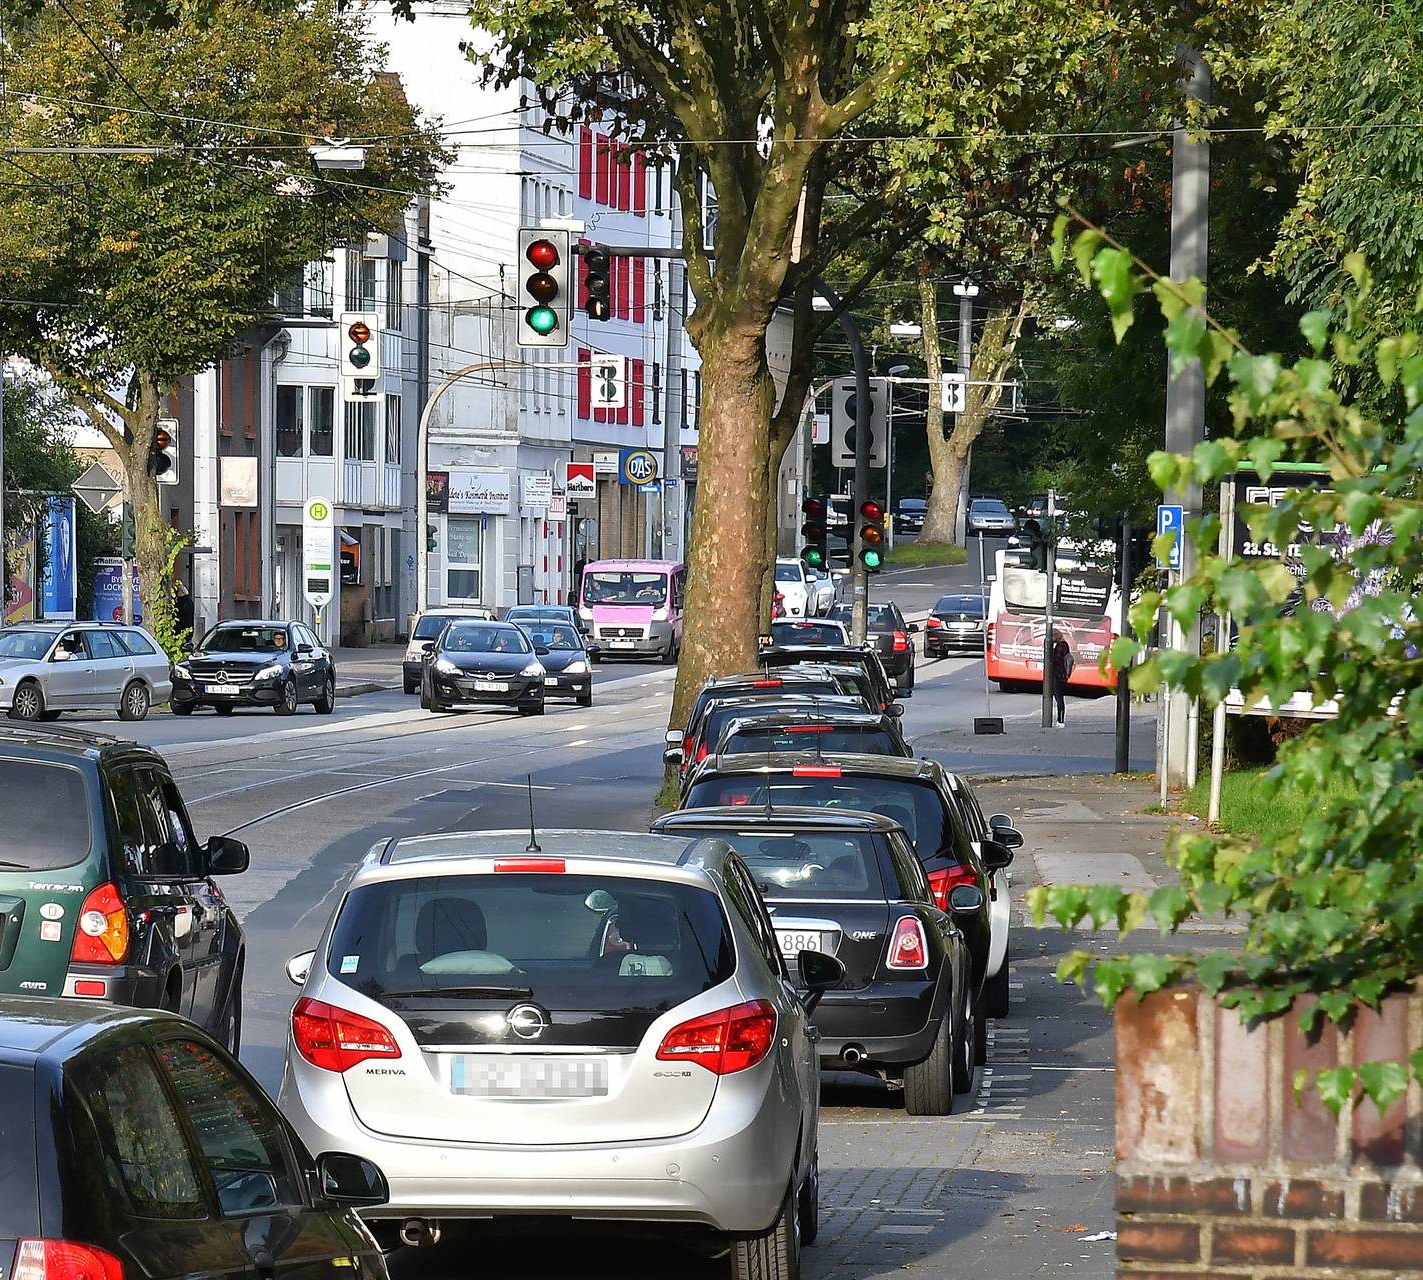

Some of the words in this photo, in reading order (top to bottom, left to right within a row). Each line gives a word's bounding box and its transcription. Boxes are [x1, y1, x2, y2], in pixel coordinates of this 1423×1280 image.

[1162, 510, 1173, 535] P
[1242, 542, 1262, 556] 23.
[27, 881, 84, 892] Terracan
[852, 931, 877, 940] ONE
[19, 981, 47, 990] 4WD
